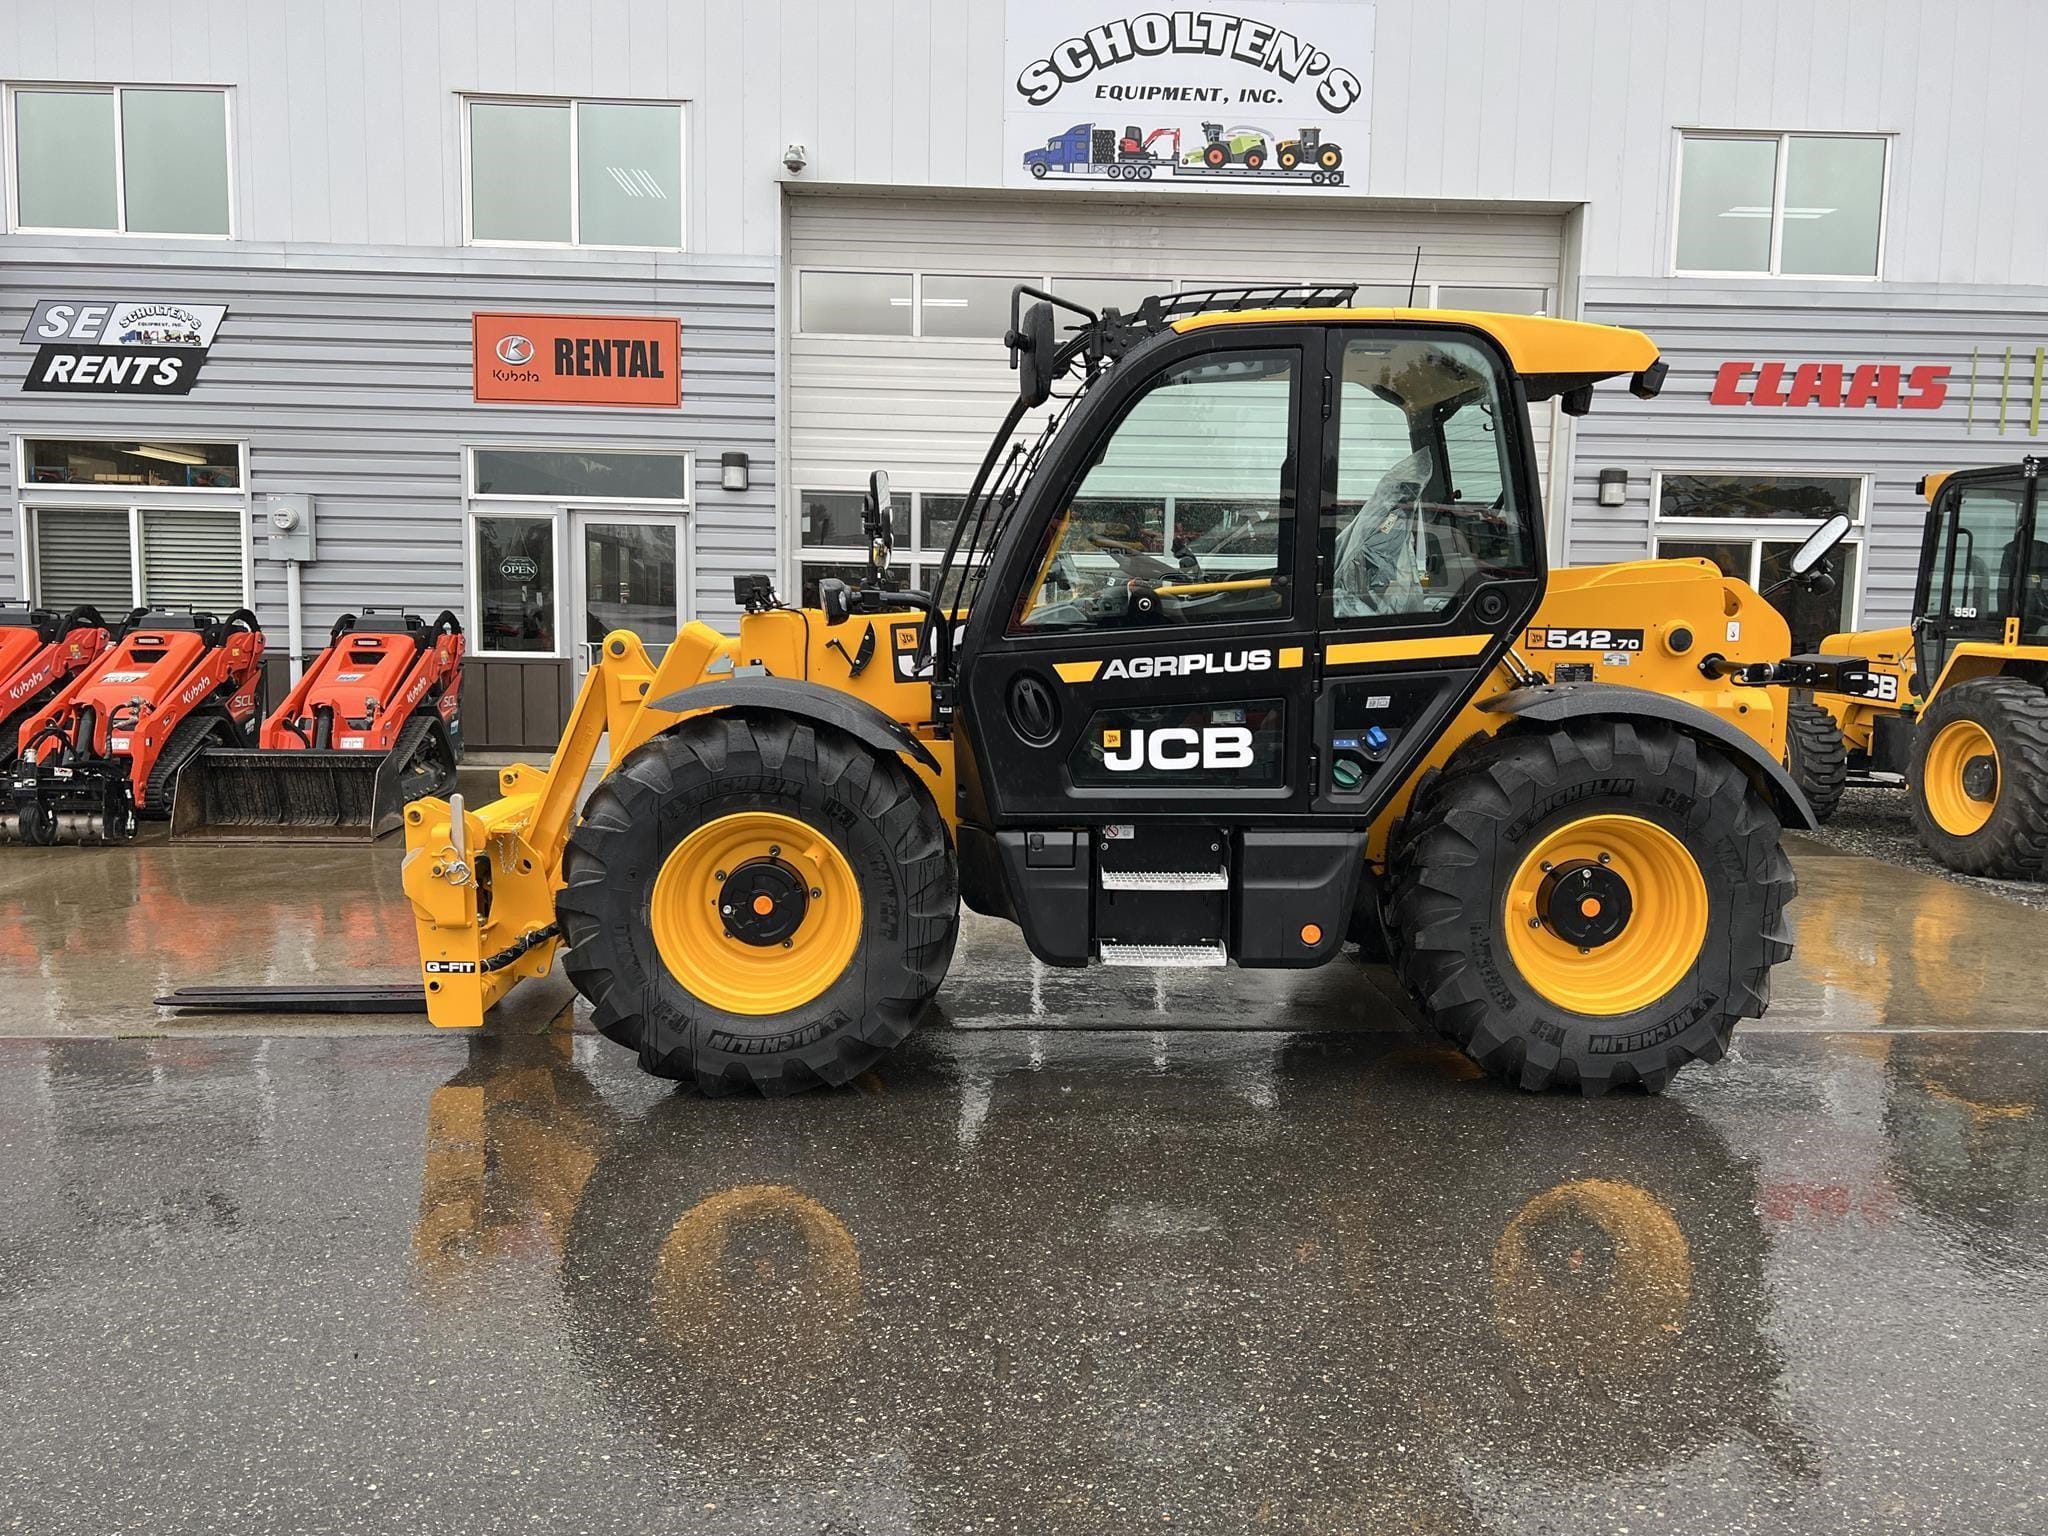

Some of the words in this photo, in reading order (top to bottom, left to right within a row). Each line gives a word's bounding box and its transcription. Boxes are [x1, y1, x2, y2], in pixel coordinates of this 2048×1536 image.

[1016, 11, 1361, 114] SCHOLTEN'S
[1095, 85, 1230, 105] EQUIPMENT,
[1239, 89, 1284, 104] INC.
[37, 305, 109, 338] SE
[119, 305, 202, 331] SCHOLTEN'S
[42, 355, 183, 386] RENTS
[554, 338, 665, 379] RENTAL
[493, 369, 540, 382] Kubota
[1710, 362, 1952, 410] CLAAS
[502, 565, 535, 574] OPEN
[1953, 607, 1977, 618] 950
[1547, 630, 1639, 649] 542-70
[1102, 649, 1272, 680] AGRIPLUS
[9, 673, 43, 700] Kubota
[182, 676, 211, 704] Kubota
[407, 676, 428, 704] Kubota
[234, 695, 254, 708] SCL
[1103, 727, 1255, 772] JCB
[426, 962, 475, 972] Q-FIT
[707, 1019, 823, 1053] MICHELIN
[1588, 1006, 1696, 1053] MICHELIN
